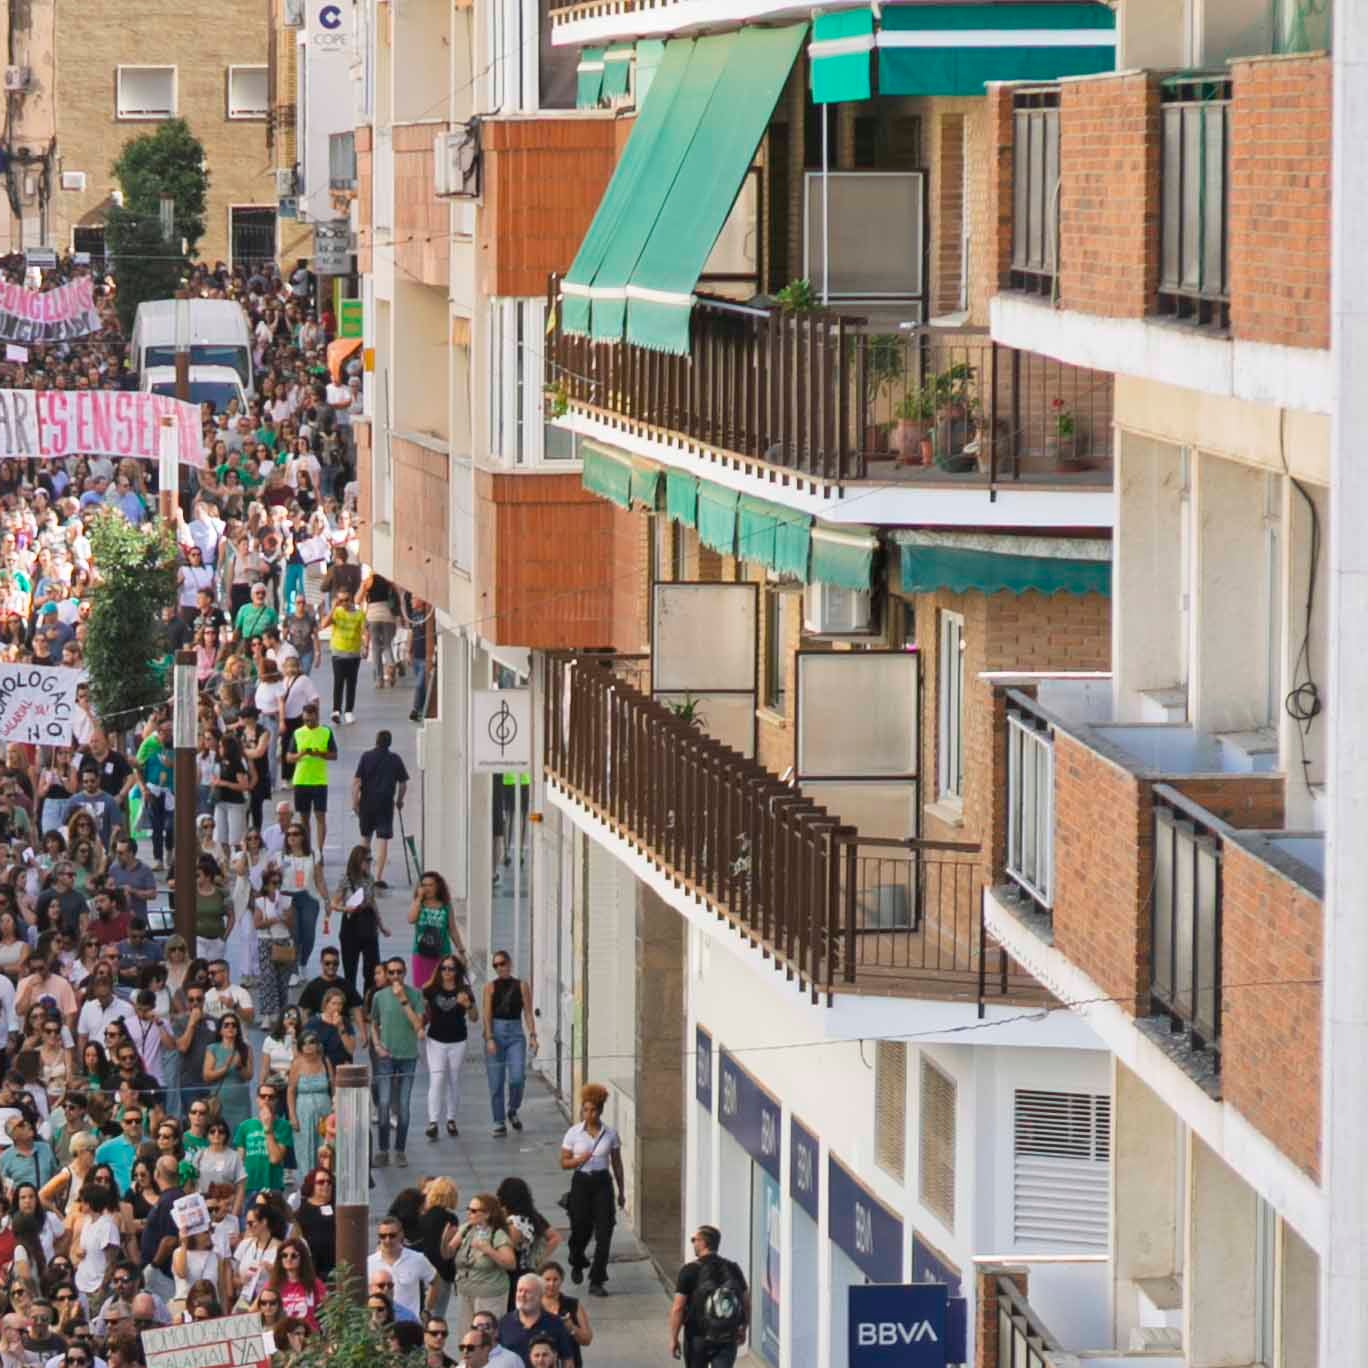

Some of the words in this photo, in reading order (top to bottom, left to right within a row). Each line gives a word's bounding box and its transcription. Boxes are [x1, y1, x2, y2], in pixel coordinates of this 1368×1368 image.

[313, 34, 348, 45] COPE
[35, 391, 68, 455] ES
[760, 1110, 776, 1156] BBVA
[797, 1144, 813, 1193] BBVA
[854, 1201, 874, 1255] BBVA
[858, 1320, 938, 1346] BBVA
